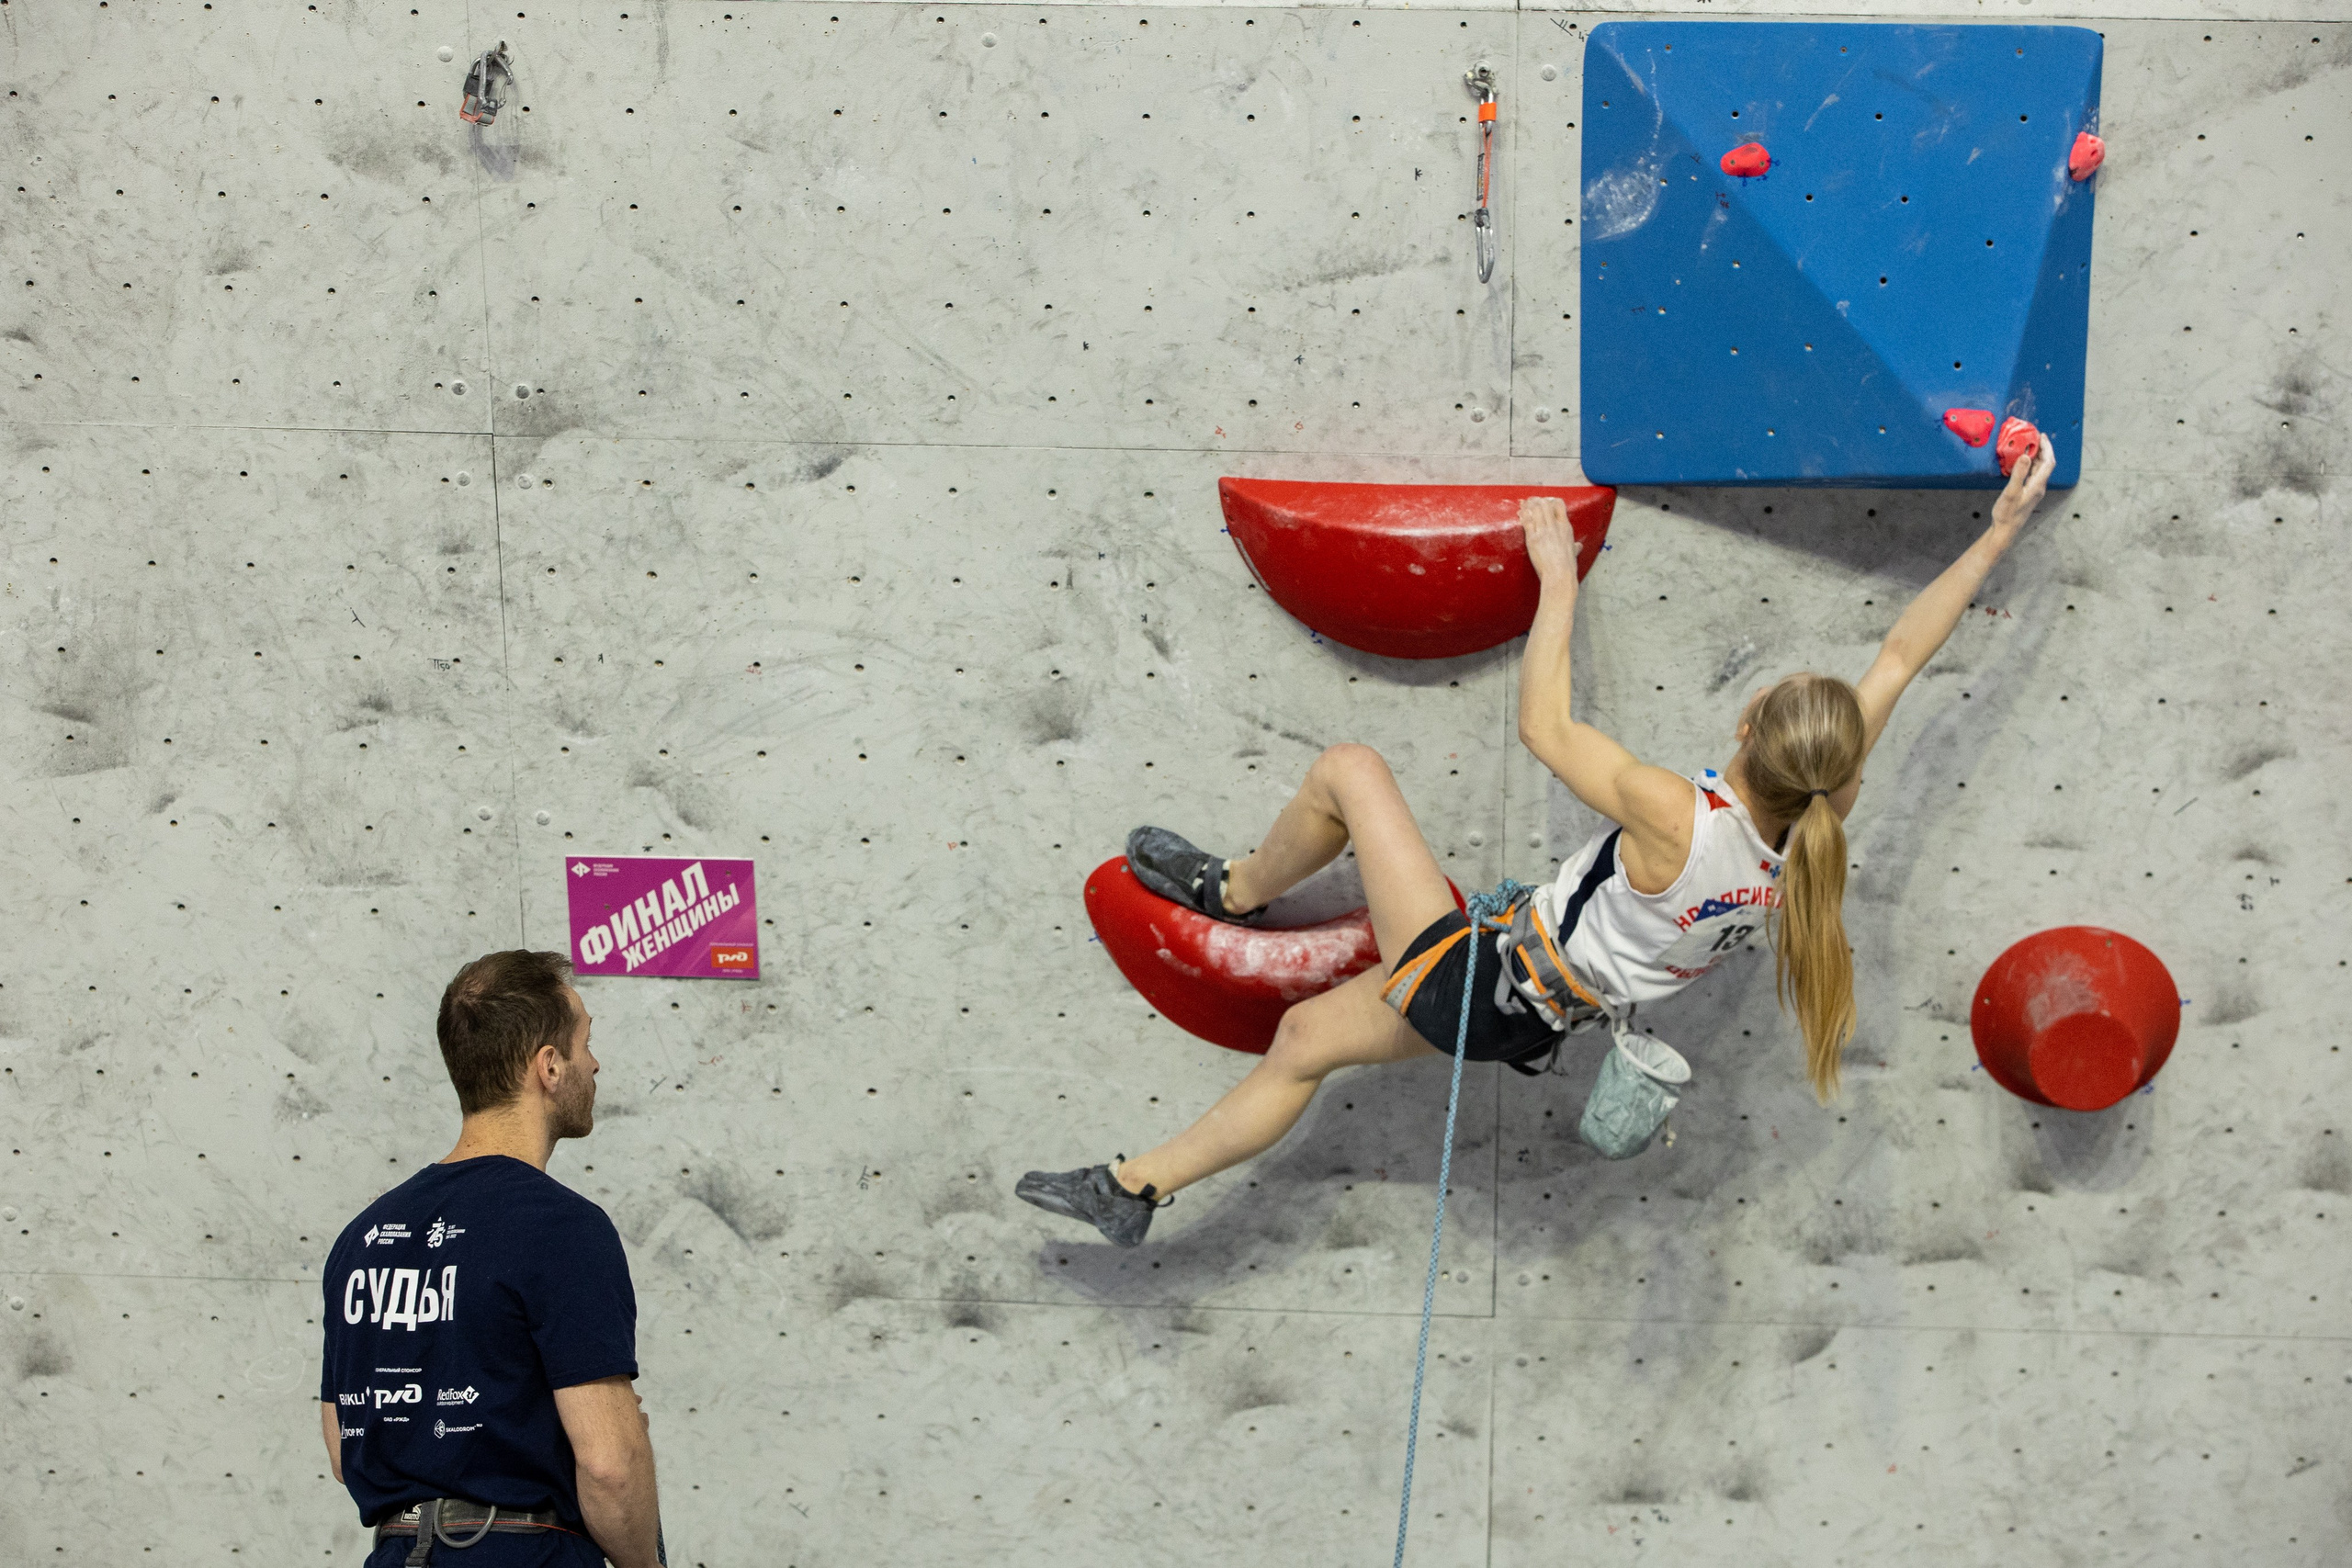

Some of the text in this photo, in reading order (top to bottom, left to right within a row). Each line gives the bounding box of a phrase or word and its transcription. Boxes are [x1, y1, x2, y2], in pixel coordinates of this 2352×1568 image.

[579, 861, 709, 964] ФИНАЛ
[621, 882, 741, 973] ЖЕНЩИНЫ
[1710, 923, 1755, 953] 13
[344, 1265, 458, 1332] СУДЬЯ
[436, 1388, 464, 1401] RedFox
